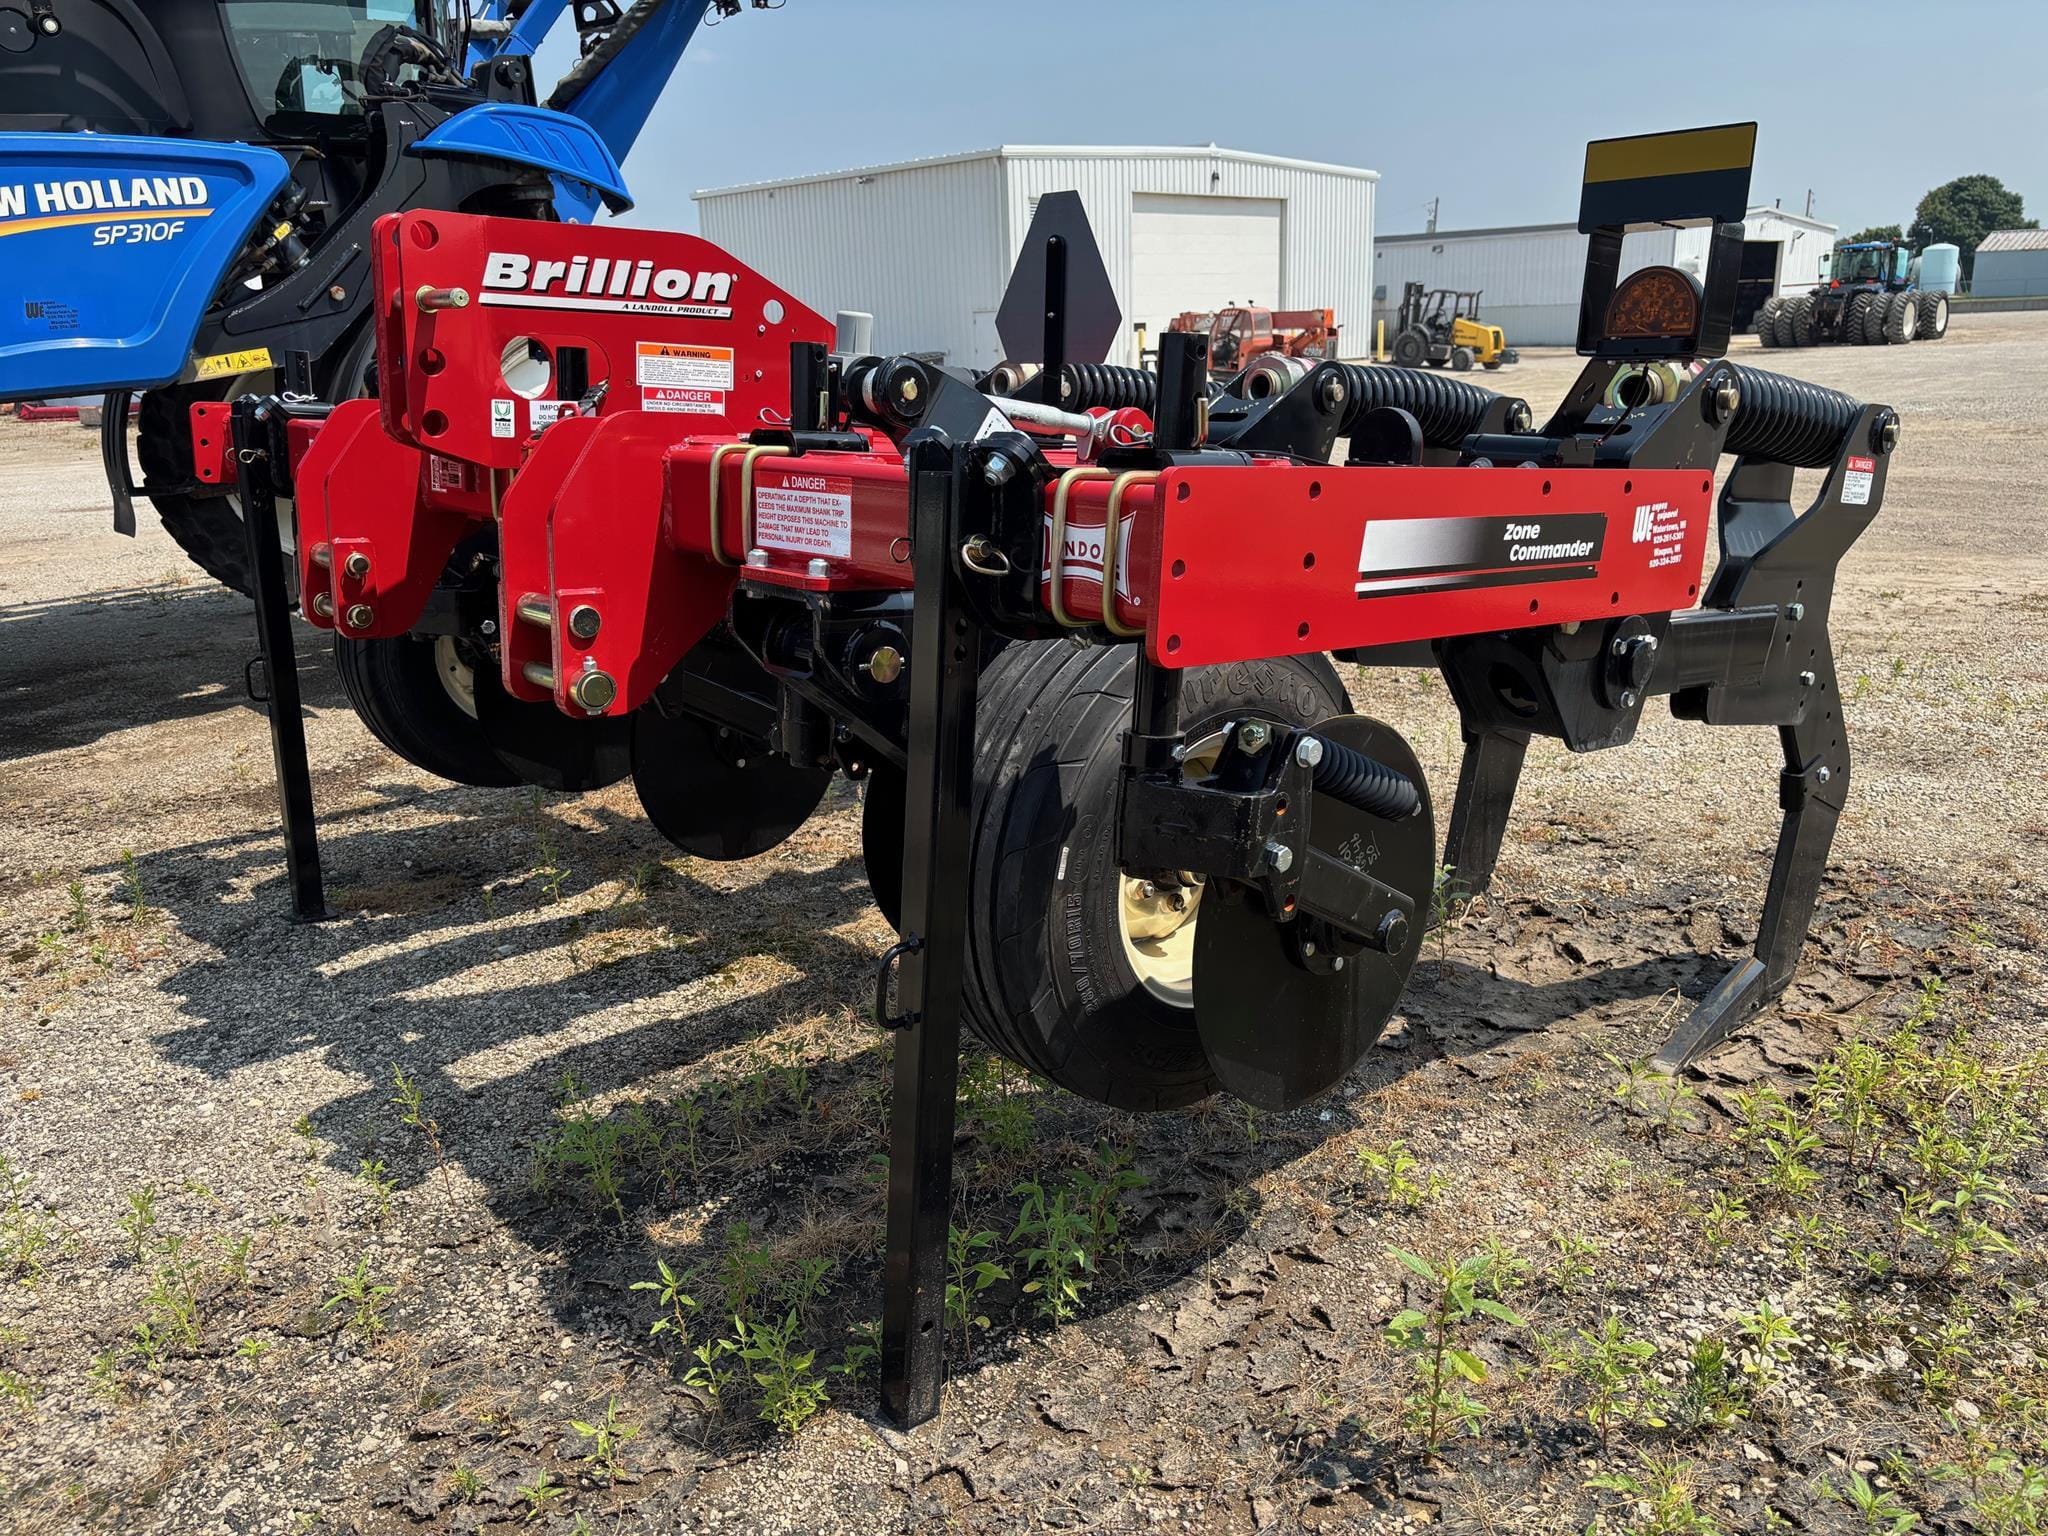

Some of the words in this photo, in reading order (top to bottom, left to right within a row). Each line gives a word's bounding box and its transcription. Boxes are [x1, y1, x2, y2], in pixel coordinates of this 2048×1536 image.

[34, 177, 208, 212] HOLLAND
[93, 221, 185, 246] SP310F
[482, 252, 733, 302] Brillion
[632, 304, 674, 312] LANDOLL
[677, 306, 719, 314] PRODUCT
[673, 350, 711, 358] WARNING
[666, 390, 712, 402] DANGER
[540, 404, 559, 412] IMPO
[791, 476, 826, 490] DANGER
[758, 492, 786, 501] OPERATING
[799, 496, 816, 504] DEPTH
[817, 497, 830, 505] THAT
[758, 502, 775, 510] CEEDS
[787, 505, 811, 514] MAXIMUM
[812, 508, 831, 516] SHANK
[758, 512, 776, 520] HEIGHT
[777, 514, 800, 523] EXPOSES
[802, 517, 814, 525] THIS
[815, 519, 839, 528] MACHINE
[839, 521, 848, 529] TO
[758, 522, 779, 531] DAMAGE
[780, 524, 793, 532] THAT
[794, 526, 805, 535] MAY
[806, 528, 820, 536] LEAD
[821, 529, 829, 537] TO
[1503, 523, 1541, 541] Zone
[758, 532, 784, 542] PERSONAL
[785, 535, 804, 545] INJURY
[804, 537, 813, 545] OR
[814, 539, 831, 548] DEATH
[1509, 540, 1594, 561] Commander
[1066, 893, 1100, 1017] 280/70R15
